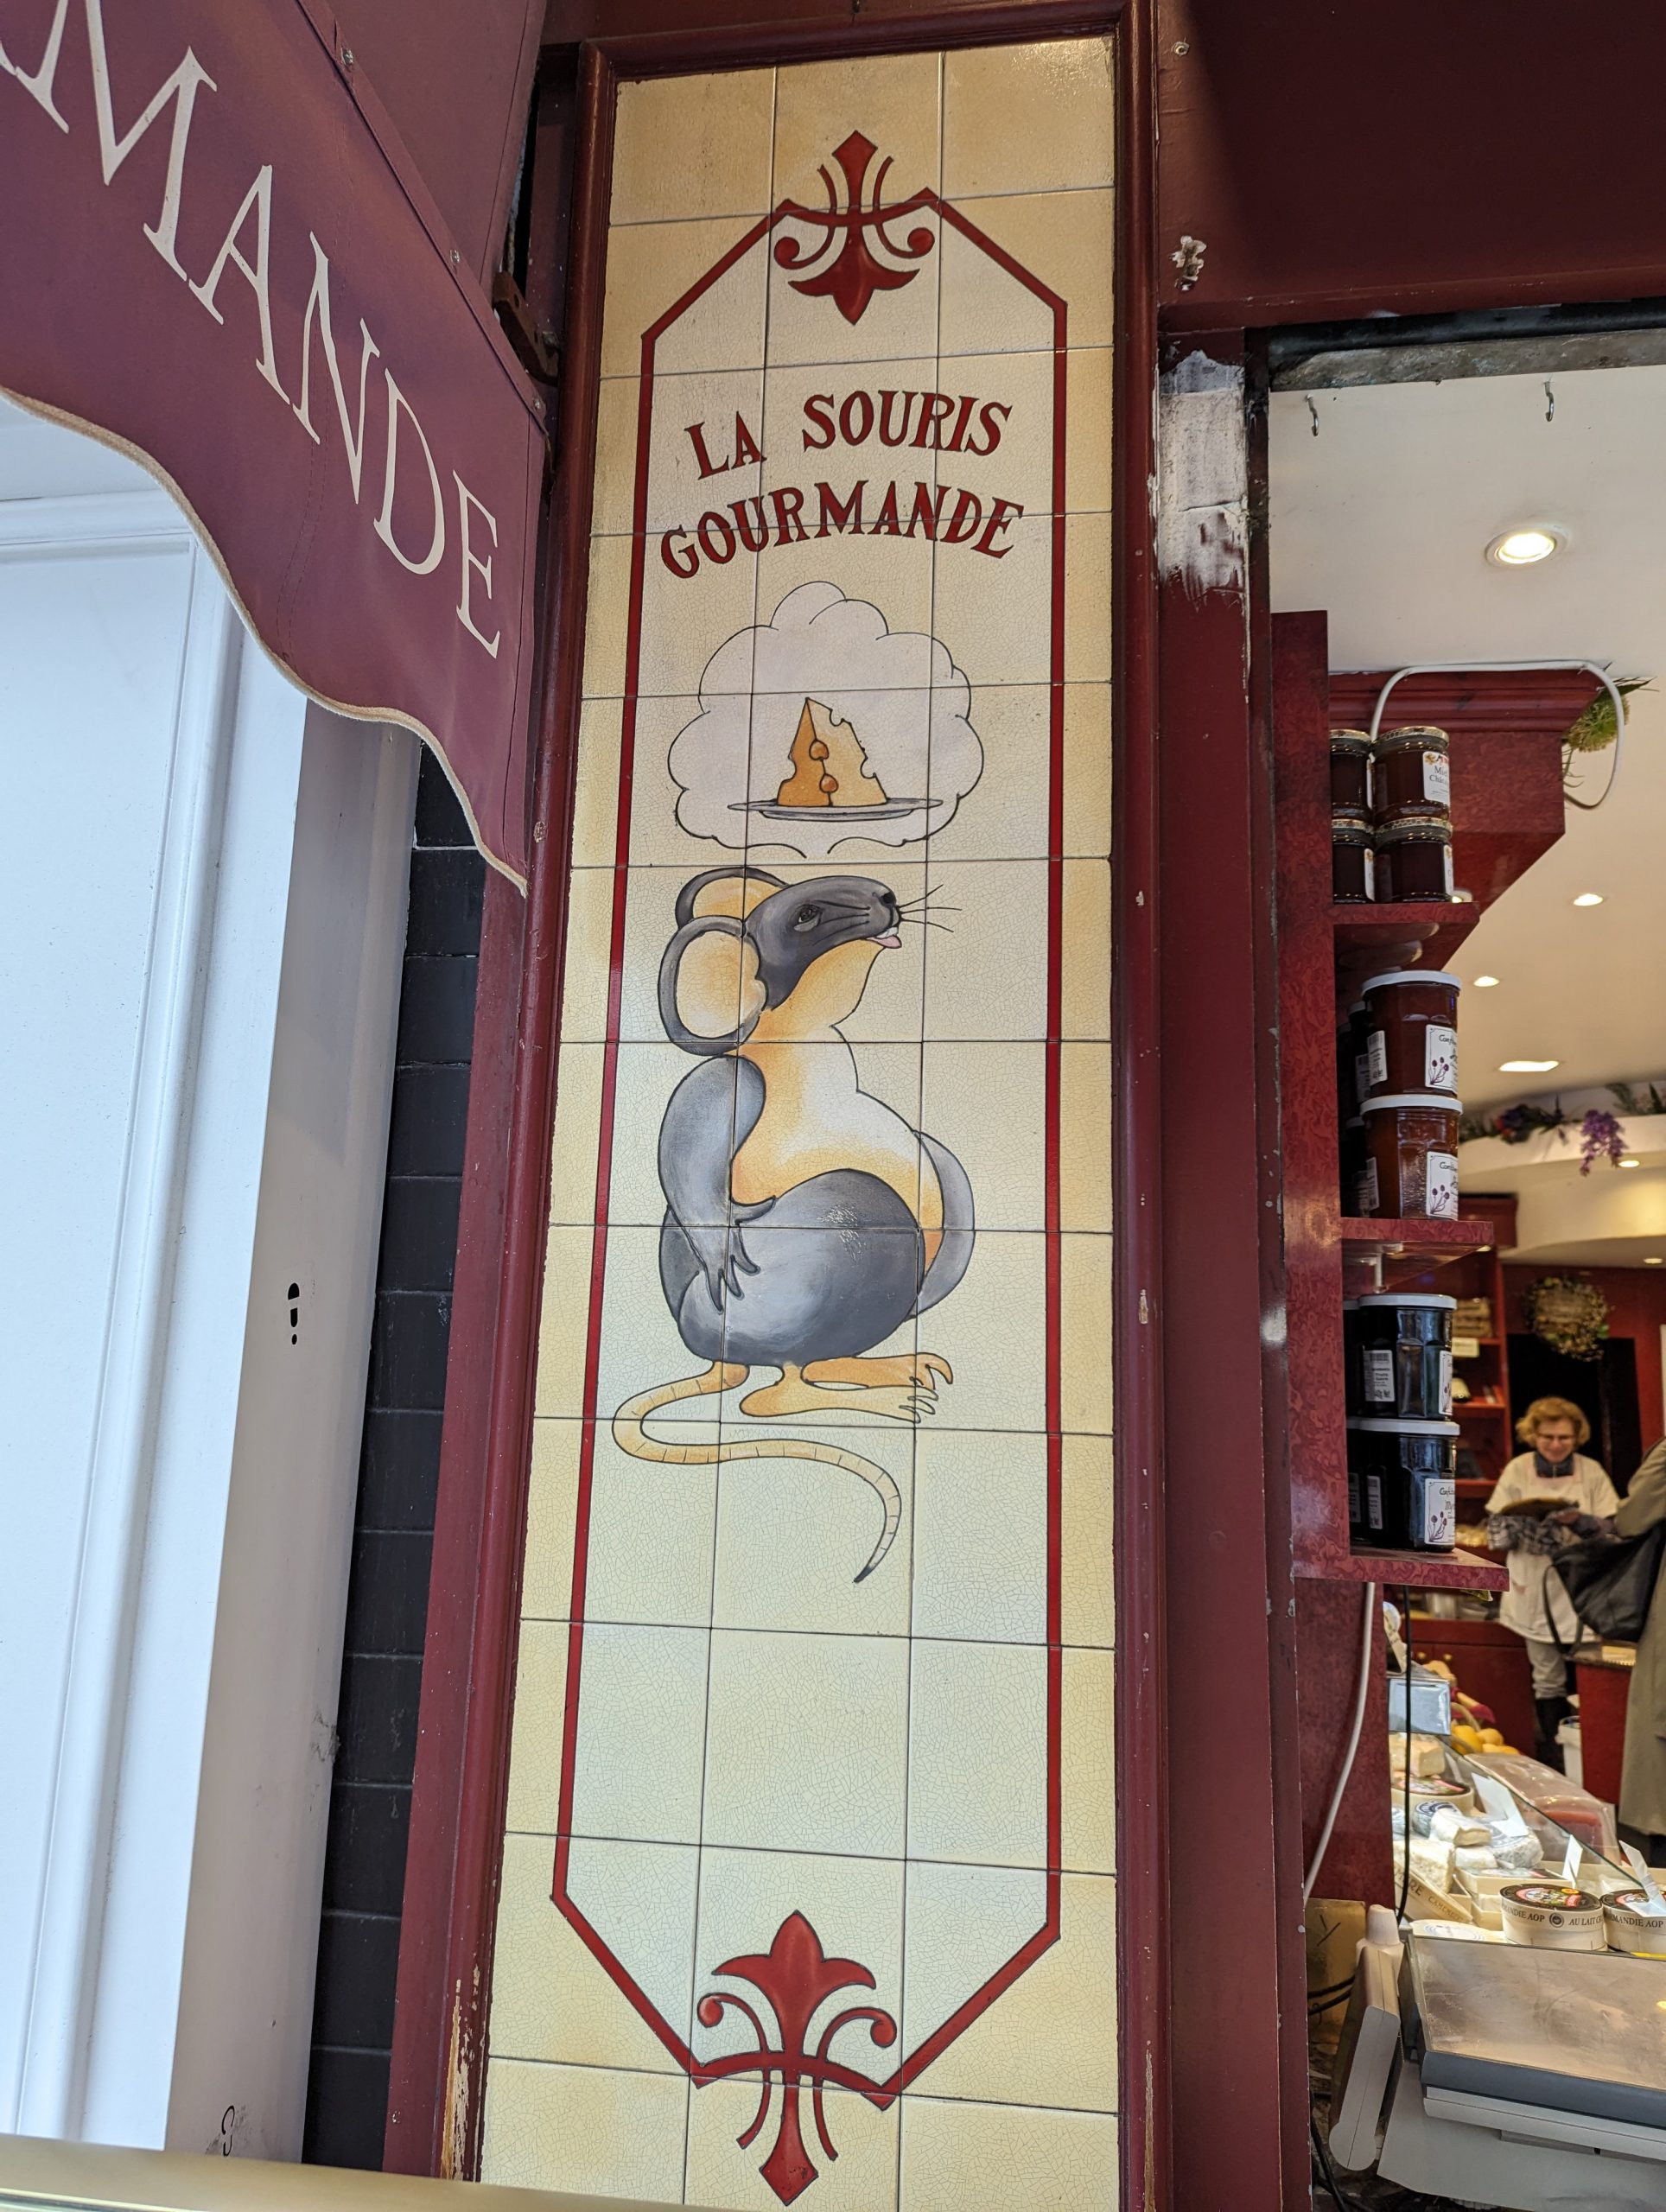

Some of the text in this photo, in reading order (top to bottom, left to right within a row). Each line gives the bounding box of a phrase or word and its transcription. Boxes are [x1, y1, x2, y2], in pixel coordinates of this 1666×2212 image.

[0, 0, 499, 658] MANDE
[684, 389, 1014, 480] LA SOURIS
[659, 480, 1025, 579] GOURMANDE
[1528, 1912, 1545, 1923] AOP
[1644, 1920, 1663, 1929] AOP
